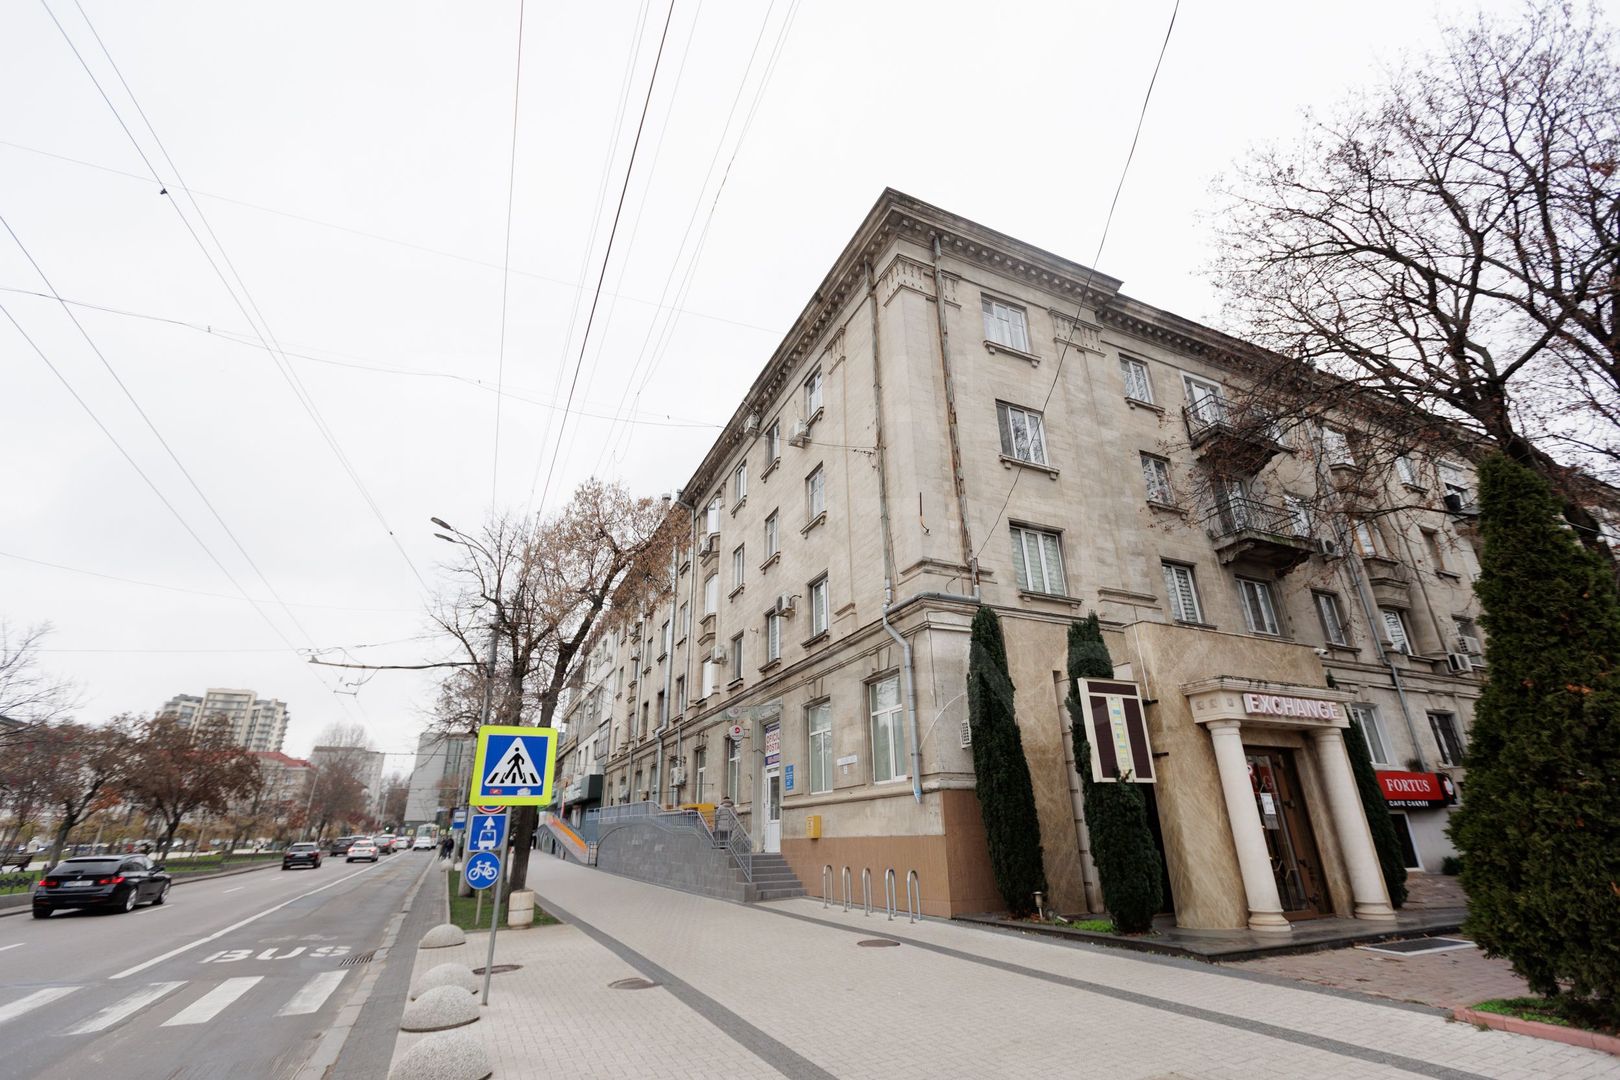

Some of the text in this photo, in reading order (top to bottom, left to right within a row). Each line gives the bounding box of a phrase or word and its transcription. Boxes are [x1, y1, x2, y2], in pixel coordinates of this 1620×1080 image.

[1244, 693, 1344, 719] EXCHANGE
[1385, 778, 1431, 792] FORTUS
[197, 946, 352, 964] BUS
